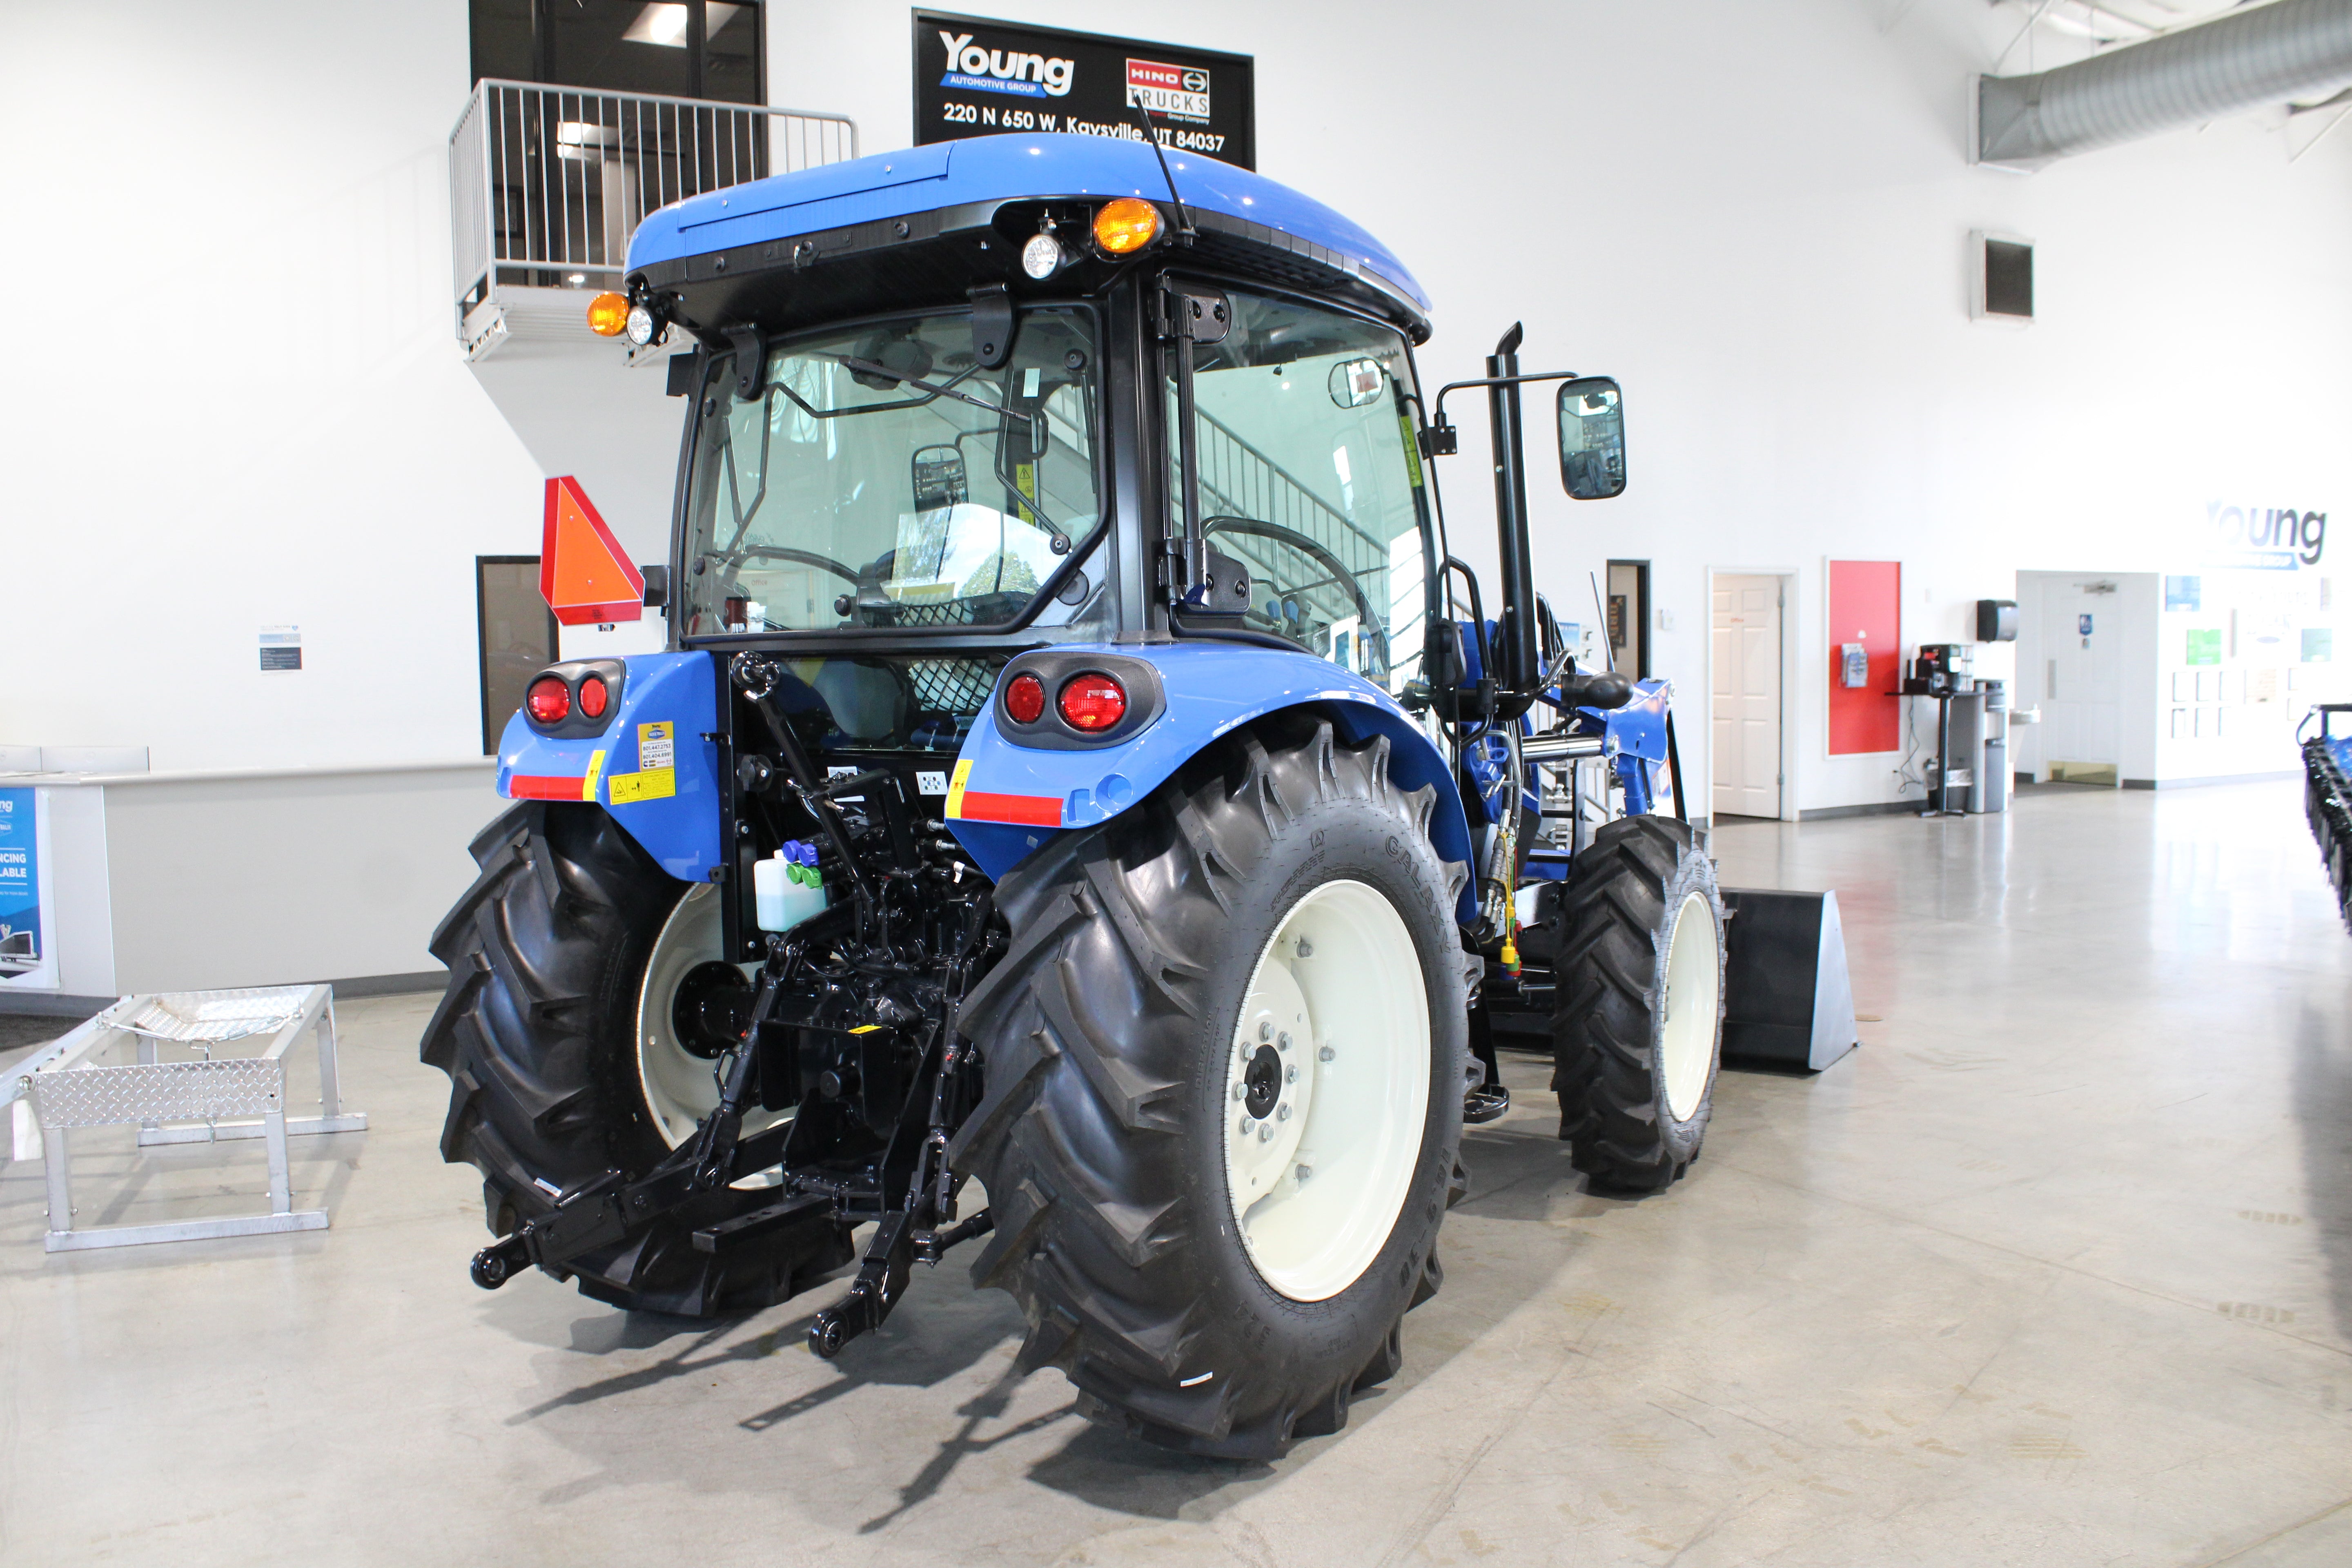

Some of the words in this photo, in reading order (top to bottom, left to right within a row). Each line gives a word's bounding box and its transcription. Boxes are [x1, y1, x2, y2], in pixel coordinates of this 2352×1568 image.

[939, 31, 1075, 97] Young
[1131, 68, 1178, 85] HINO
[950, 75, 1005, 89] AUTOMOTIVE
[1007, 81, 1036, 93] GROUP
[1129, 87, 1207, 113] TRUCKS
[944, 102, 977, 123] 220
[983, 107, 996, 126] N
[1002, 109, 1034, 130] 650
[1039, 113, 1061, 133] W,
[1153, 127, 1172, 145] UT
[1176, 130, 1225, 152] 84037
[1167, 112, 1184, 121] Group
[1185, 115, 1210, 125] Company
[1385, 835, 1451, 953] GALAXY
